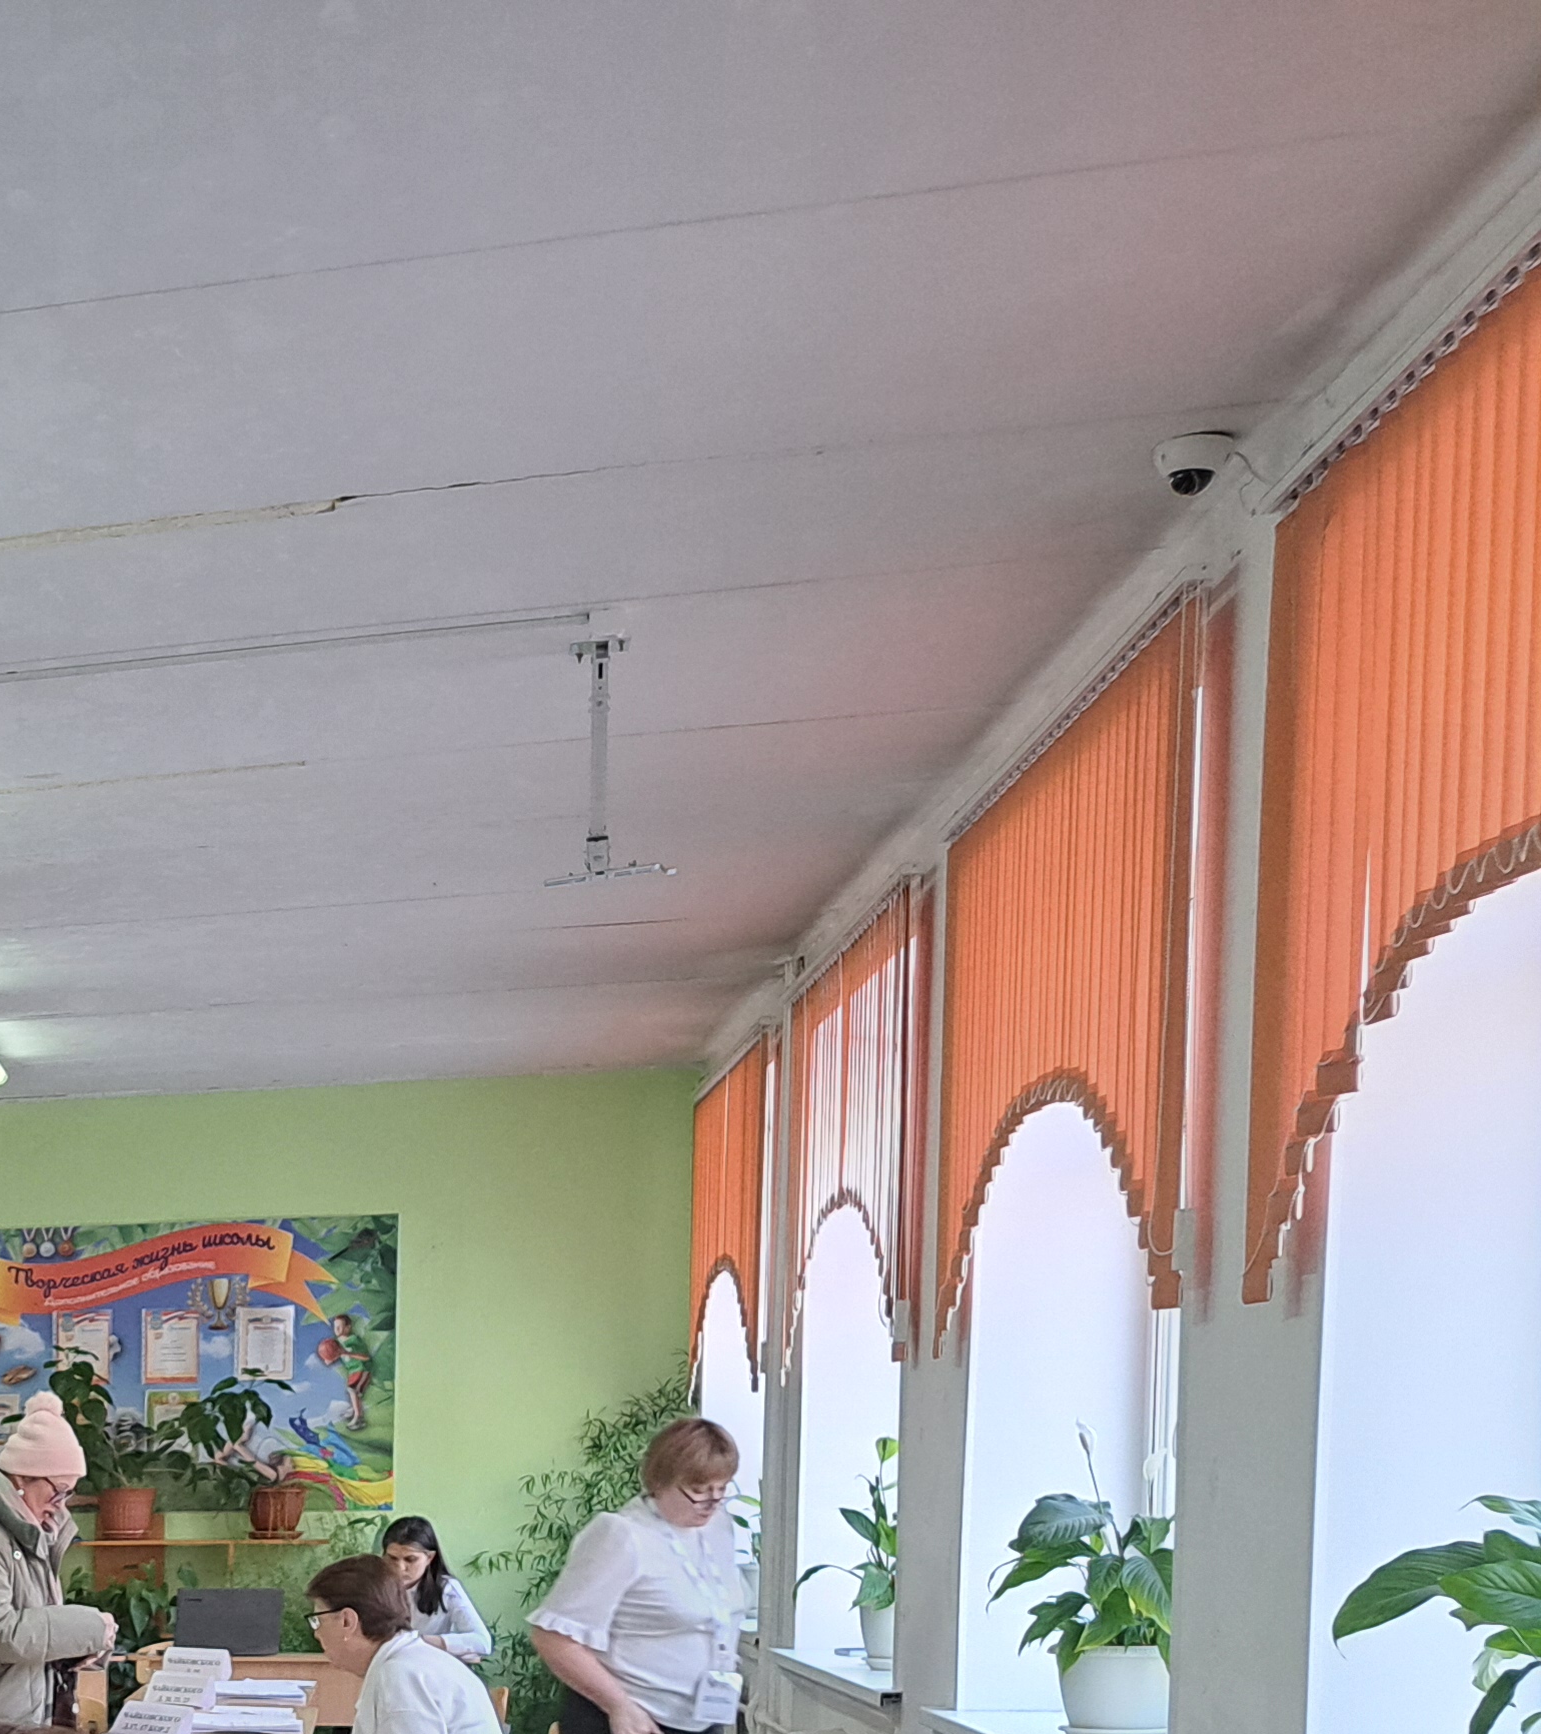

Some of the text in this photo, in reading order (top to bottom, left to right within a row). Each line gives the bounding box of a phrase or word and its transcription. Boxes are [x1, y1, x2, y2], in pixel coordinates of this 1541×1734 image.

[7, 1232, 276, 1298] Творческая жизнь школы
